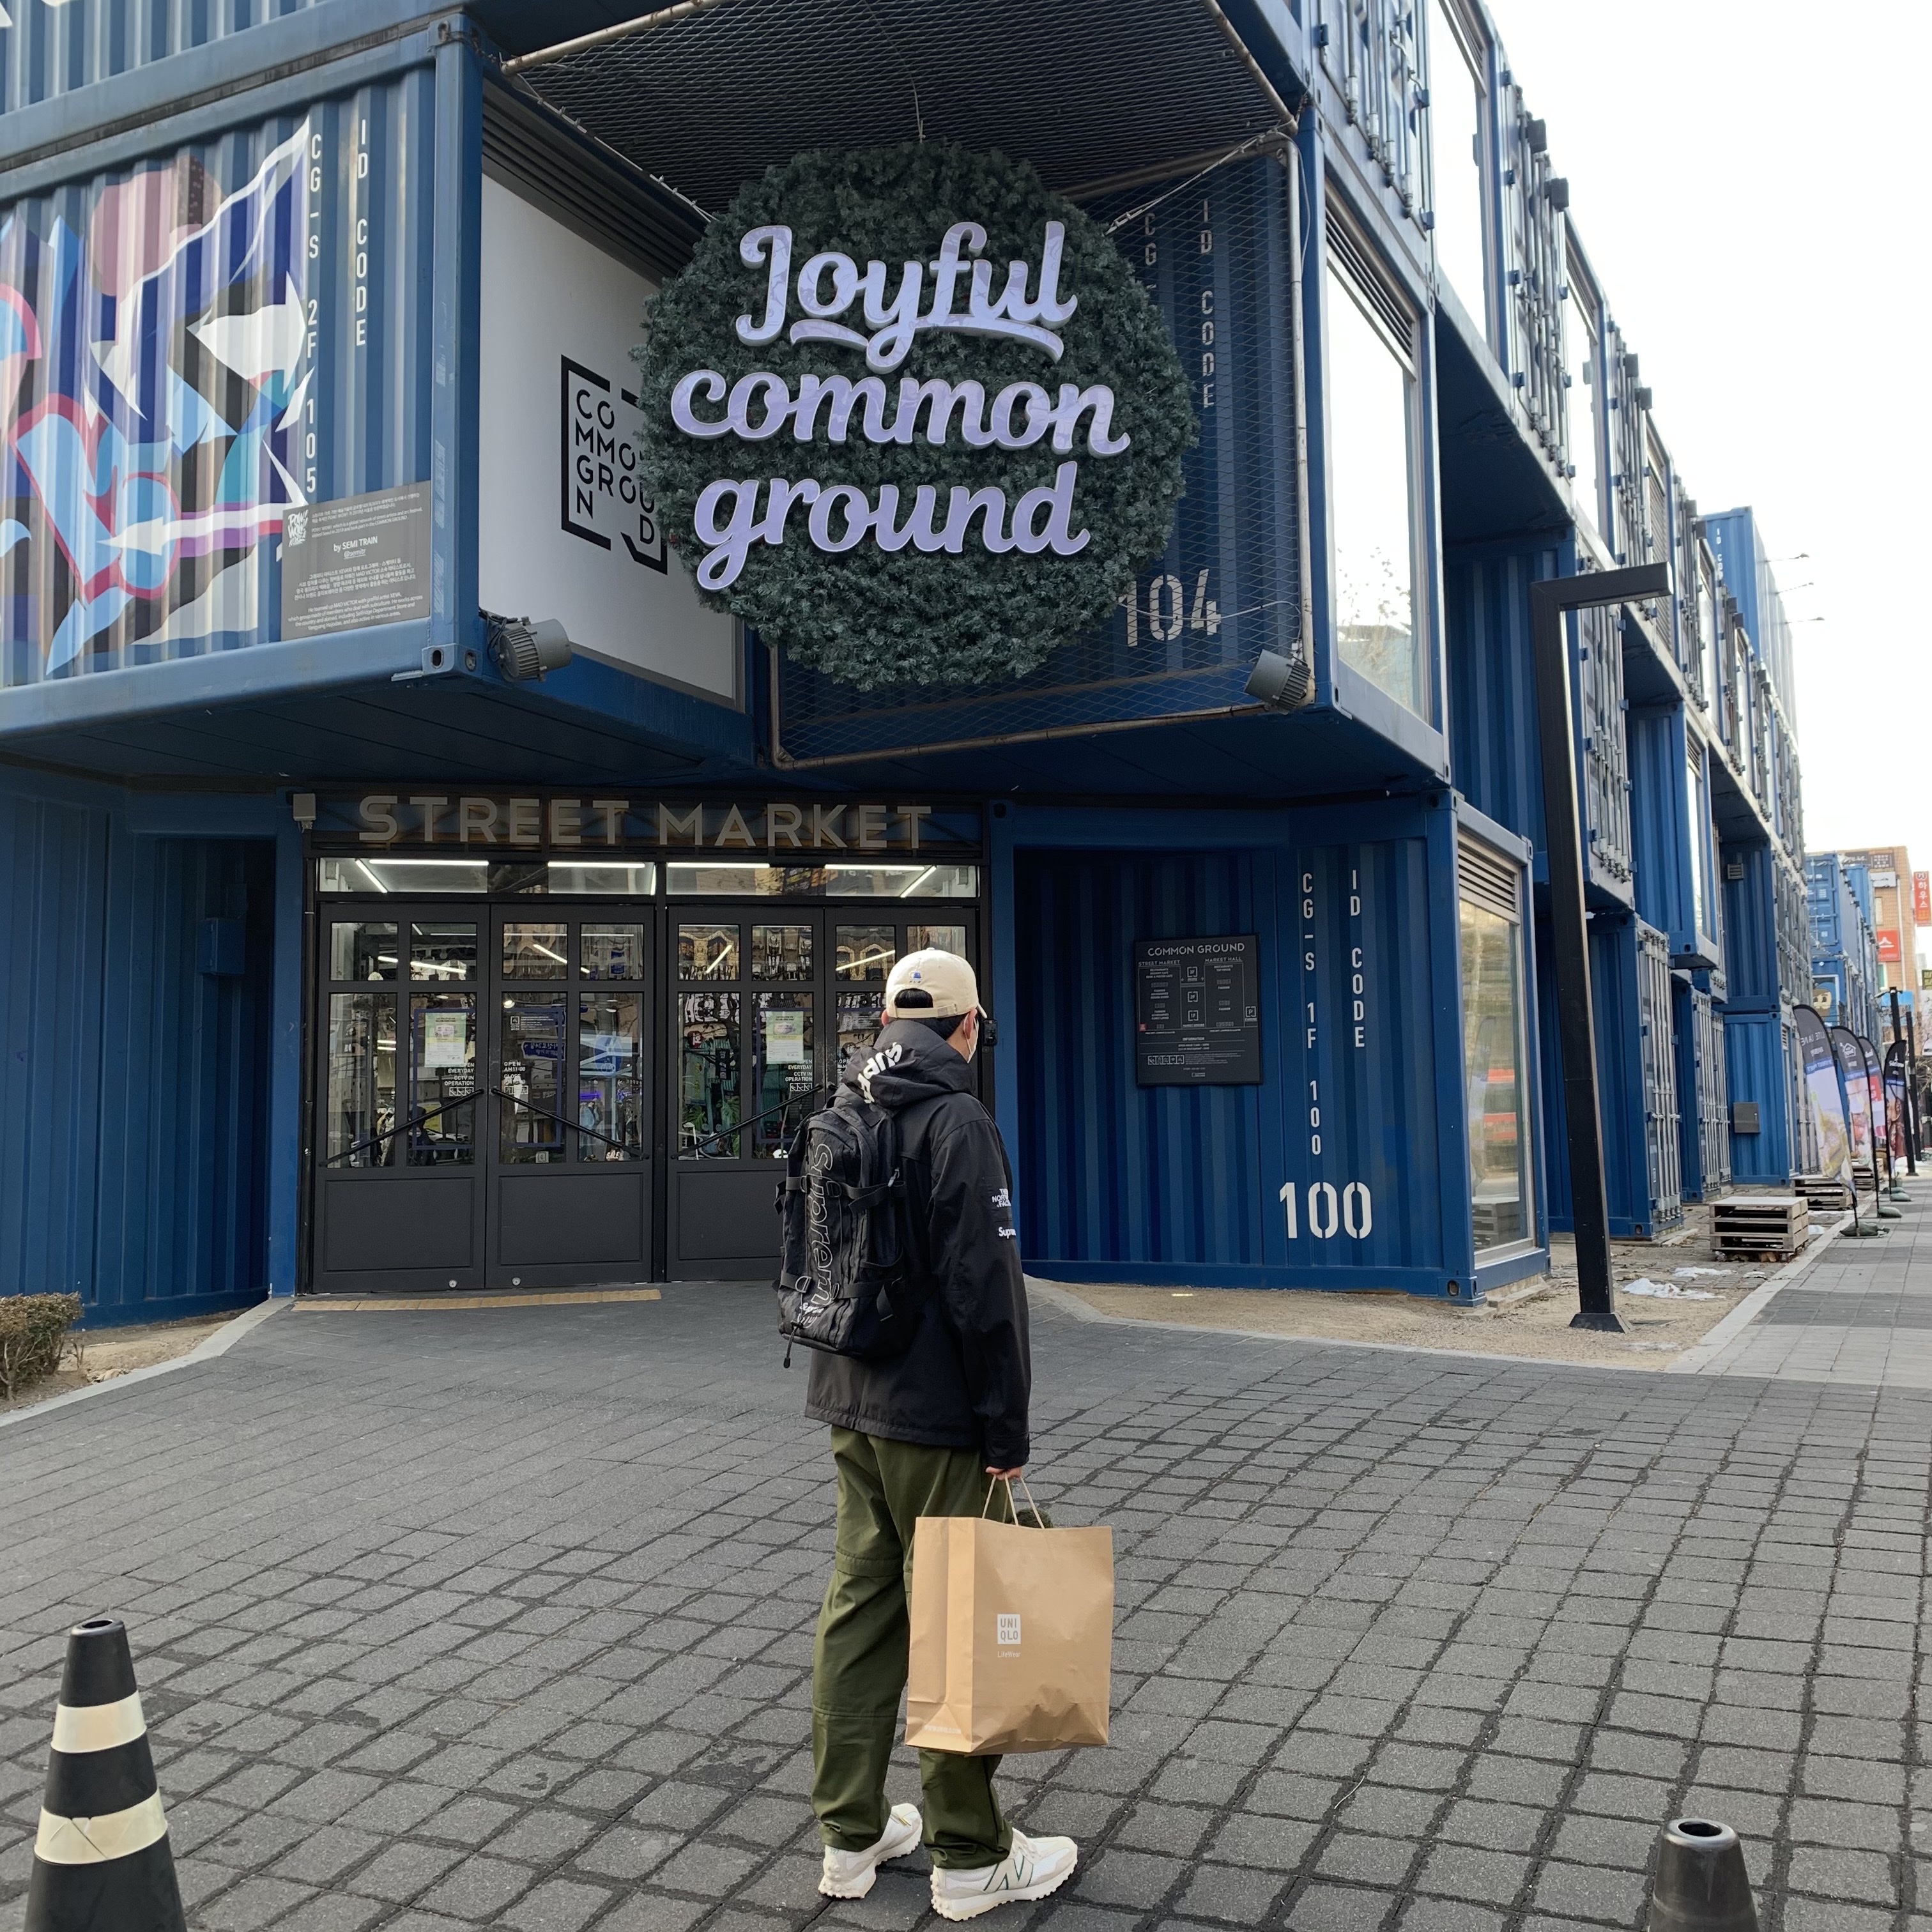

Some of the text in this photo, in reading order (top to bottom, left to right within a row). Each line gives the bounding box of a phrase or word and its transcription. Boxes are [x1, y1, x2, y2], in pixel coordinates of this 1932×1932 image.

[355, 118, 367, 347] ID CODE
[305, 134, 322, 493] CG-S 2F 105
[736, 221, 1078, 374] Joyful
[1200, 198, 1215, 409] ID CODE
[576, 417, 643, 471] MMO
[670, 369, 1131, 459] common
[334, 536, 378, 553] by SEMI TRAIN
[694, 461, 1092, 591] ground
[1123, 568, 1222, 648] 104
[358, 795, 933, 850] STREET MARKET
[1147, 943, 1245, 956] COMMON GROUND
[1349, 870, 1365, 1047] ID CODE
[1303, 873, 1321, 1155] CG-S 1F 100
[1279, 1181, 1372, 1239] 100
[1000, 1618, 1016, 1628] UNI
[1000, 1630, 1018, 1642] QLO
